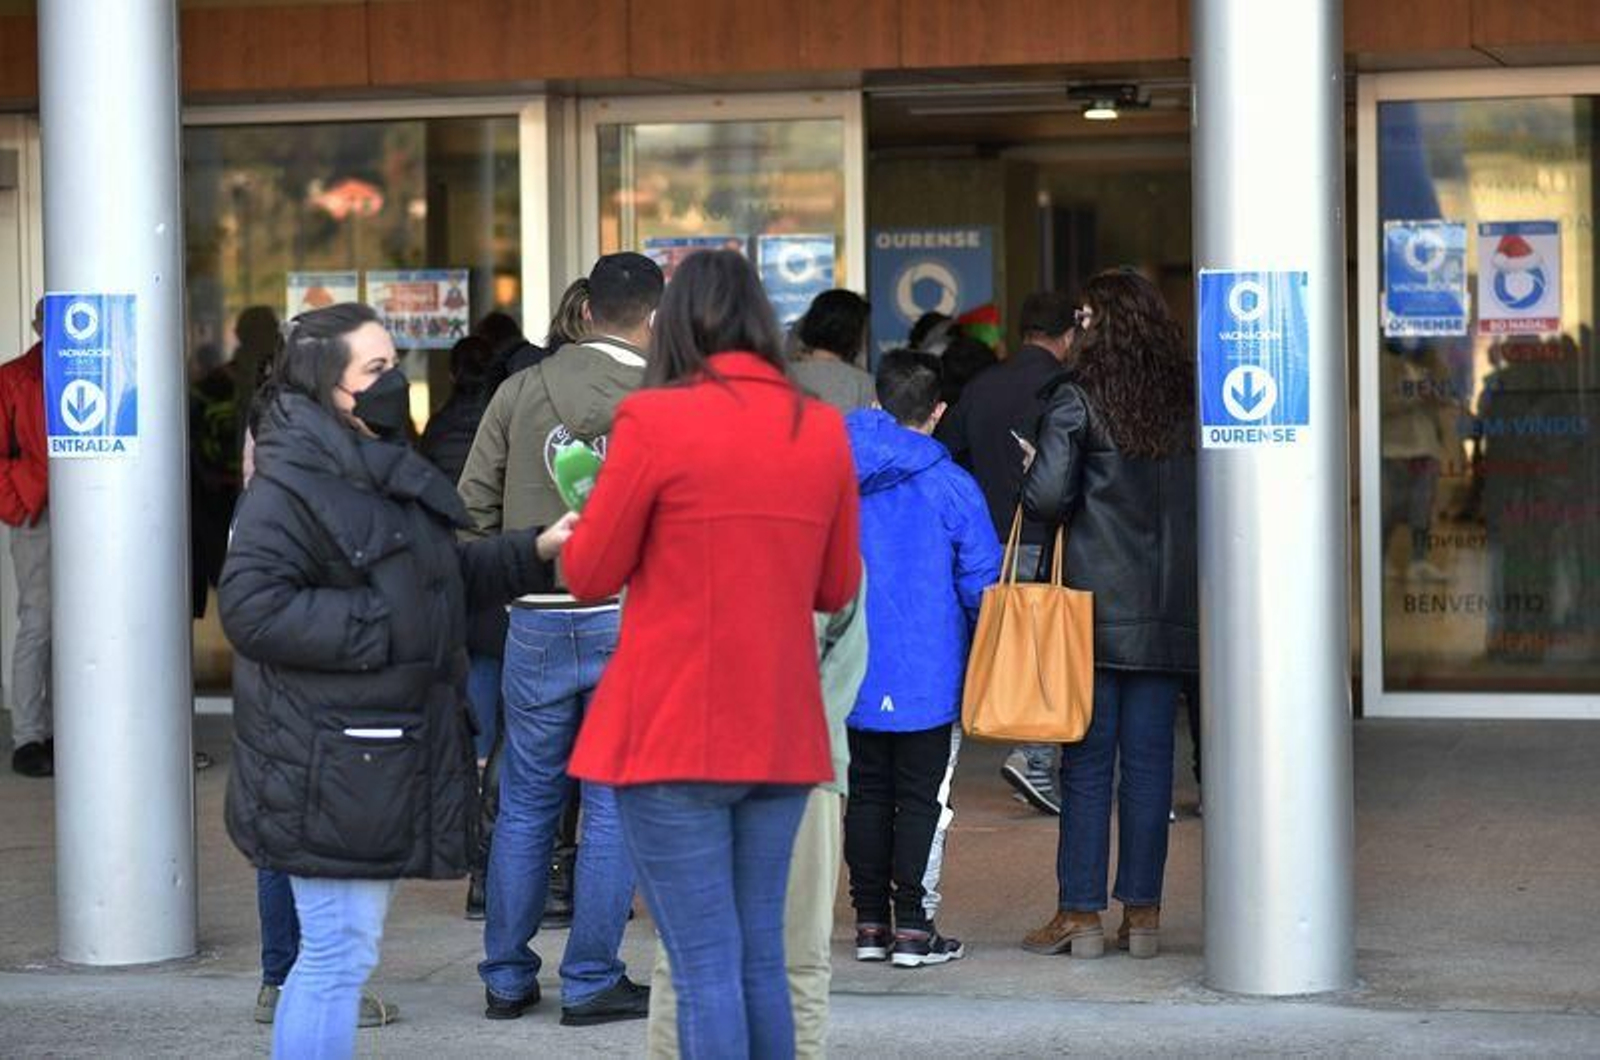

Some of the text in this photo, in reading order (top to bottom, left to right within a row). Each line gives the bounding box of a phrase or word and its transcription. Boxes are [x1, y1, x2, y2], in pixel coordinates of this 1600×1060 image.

[876, 230, 981, 249] OURENSE
[1210, 428, 1297, 443] OURENSE
[53, 438, 126, 453] ENTRADA
